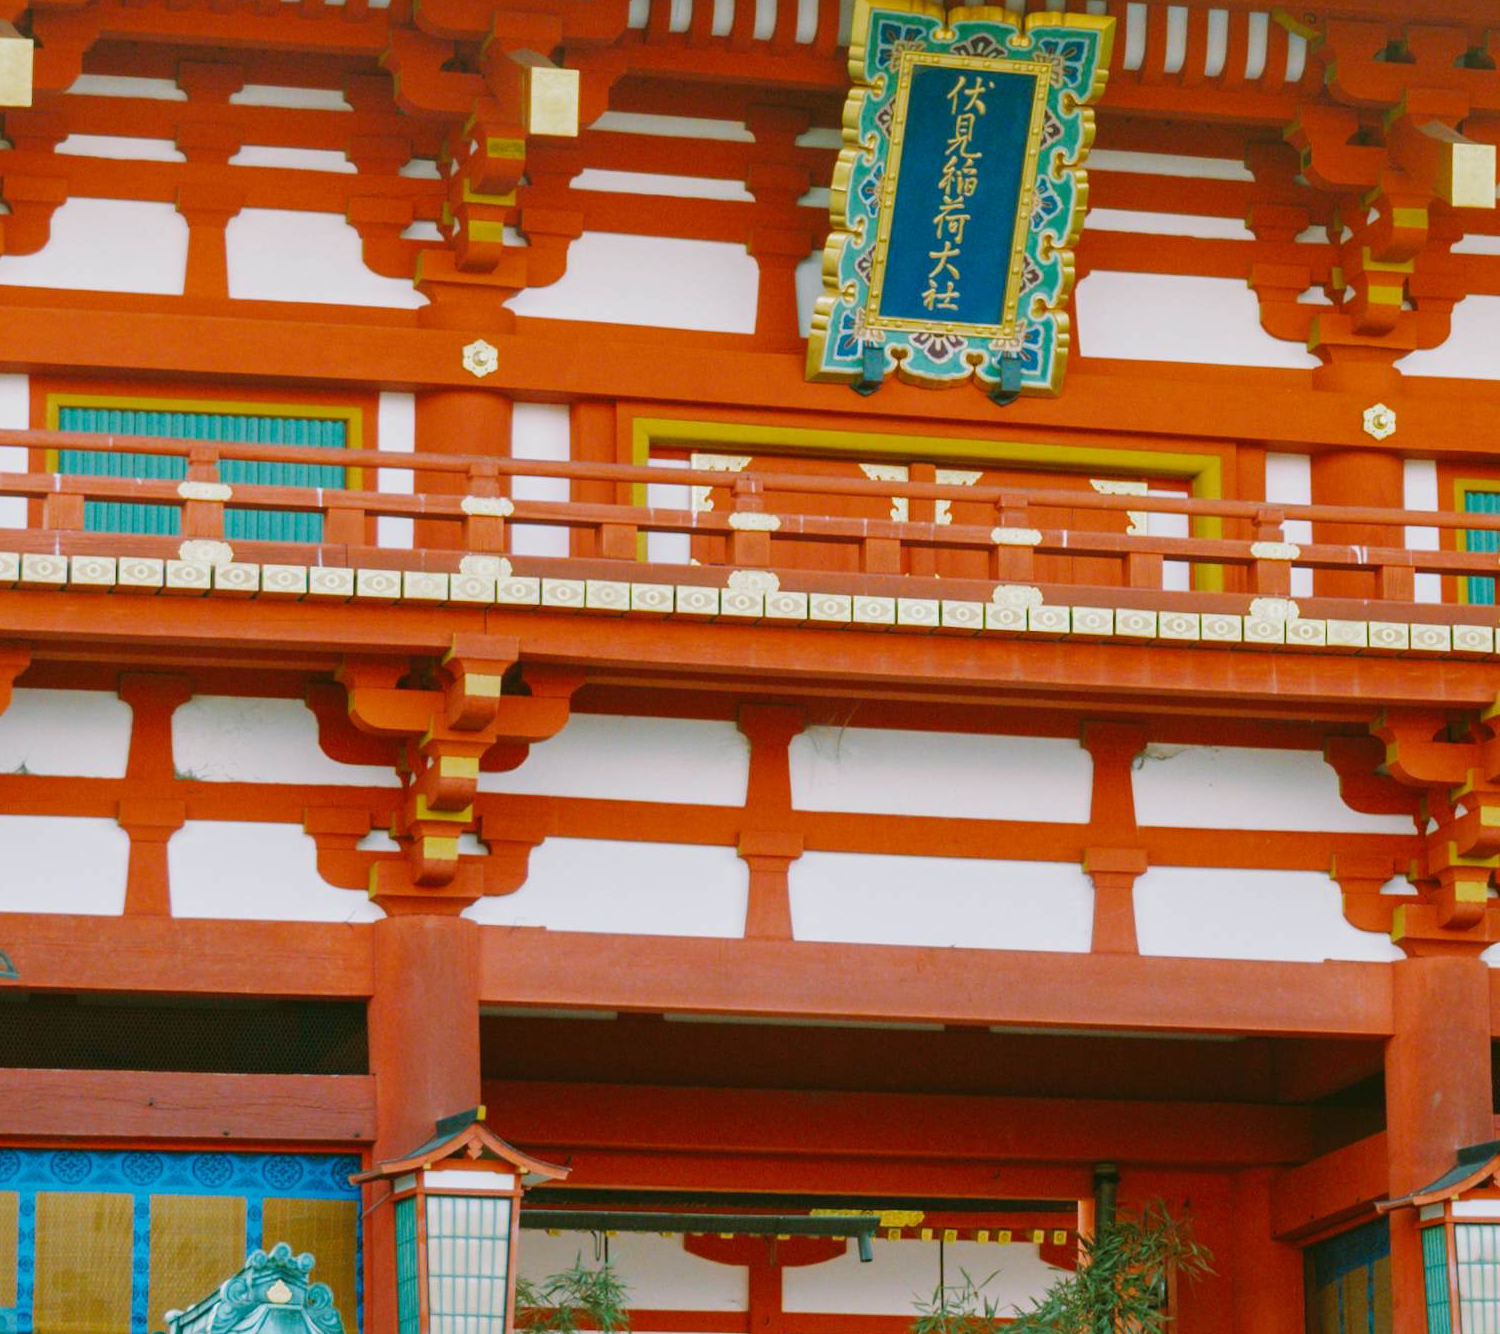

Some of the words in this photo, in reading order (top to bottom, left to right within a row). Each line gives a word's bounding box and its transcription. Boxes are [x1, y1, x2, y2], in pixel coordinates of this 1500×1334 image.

[921, 75, 995, 312] 伏見稲荷大社
